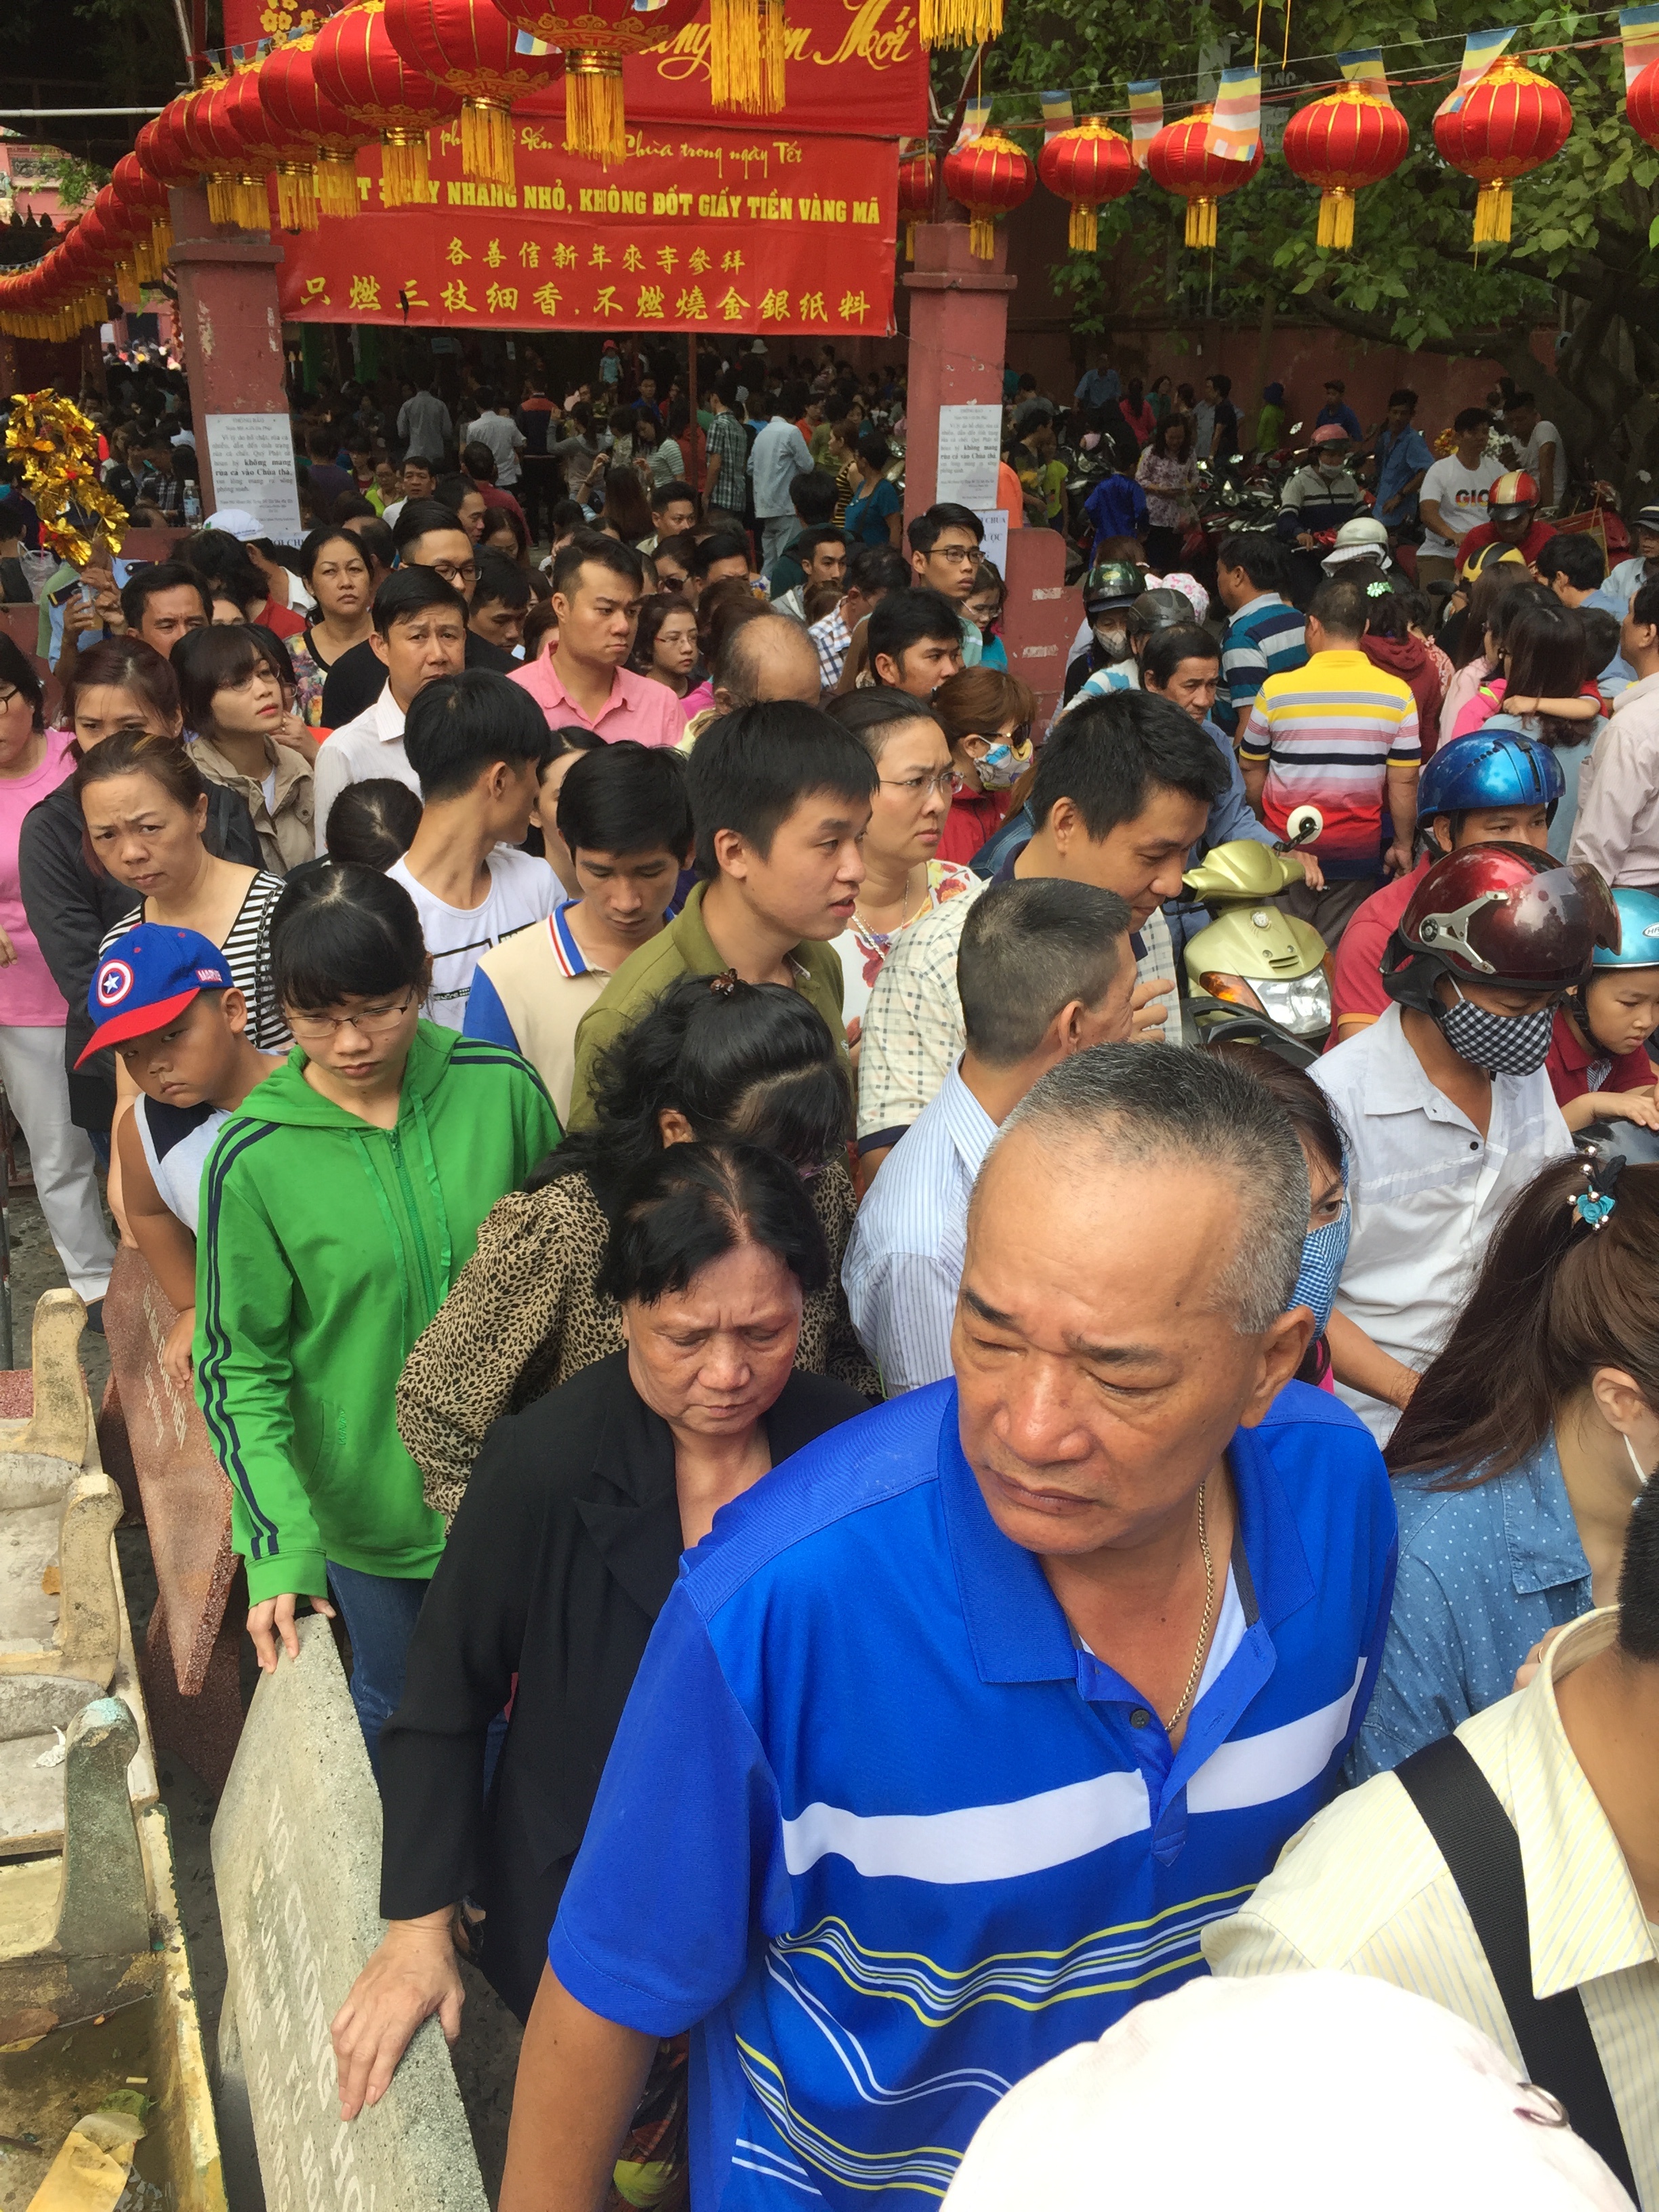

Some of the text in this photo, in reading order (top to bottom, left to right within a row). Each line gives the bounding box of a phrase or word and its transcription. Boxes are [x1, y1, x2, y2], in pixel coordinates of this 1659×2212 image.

[680, 142, 722, 179] trong
[729, 145, 768, 180] ngày
[773, 141, 803, 164] Tết
[447, 181, 517, 208] NHANG
[523, 178, 573, 213] NHỎ,
[579, 184, 647, 214] KHÔNG
[653, 184, 693, 216] ĐỐT
[698, 186, 742, 218] GIẤY
[747, 188, 792, 220] TIỀN
[798, 192, 847, 223] VÀNG
[852, 197, 880, 224] MÃ
[300, 2131, 325, 2212] ĐÔ
